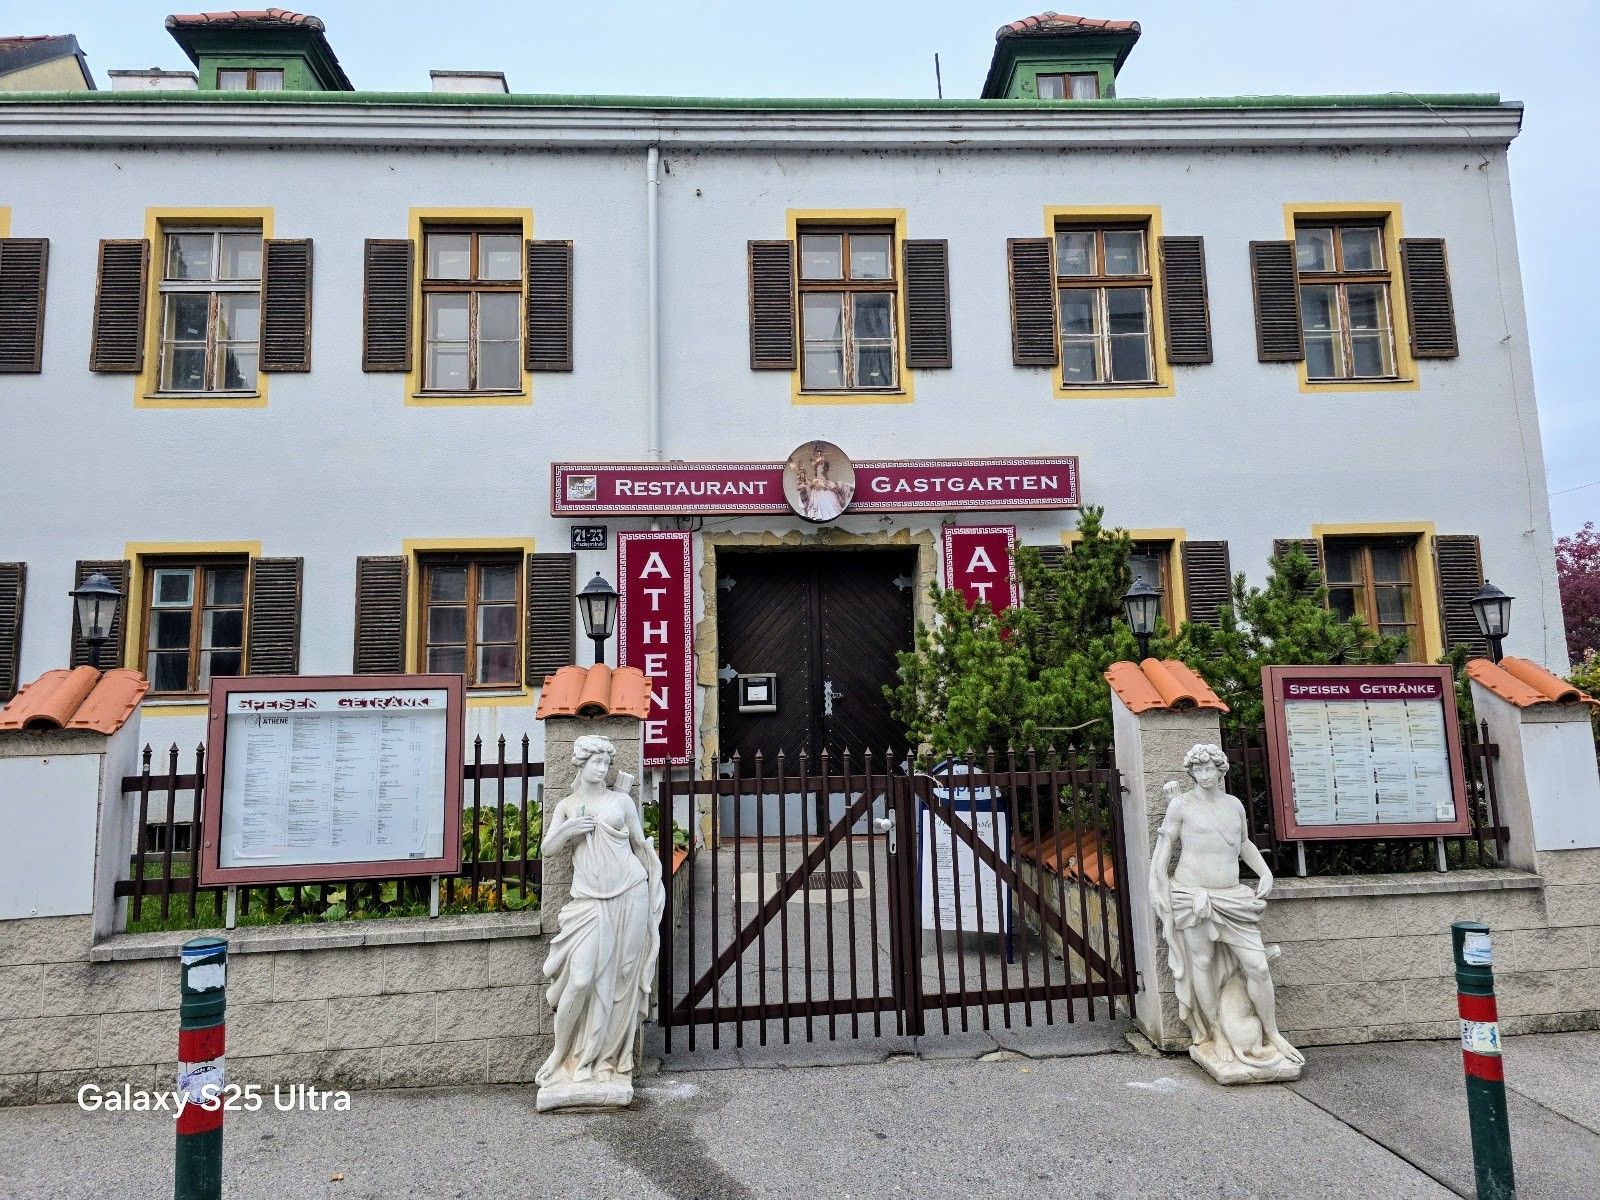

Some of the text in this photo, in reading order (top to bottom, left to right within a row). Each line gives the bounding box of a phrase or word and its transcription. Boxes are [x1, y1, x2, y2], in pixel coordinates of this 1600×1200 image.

[615, 475, 1058, 496] RESTAURANT GASTGARTEN
[639, 551, 672, 745] ATHENE
[1289, 682, 1435, 695] SPEISEN GETRÄNKE
[238, 698, 319, 711] SPEISEN
